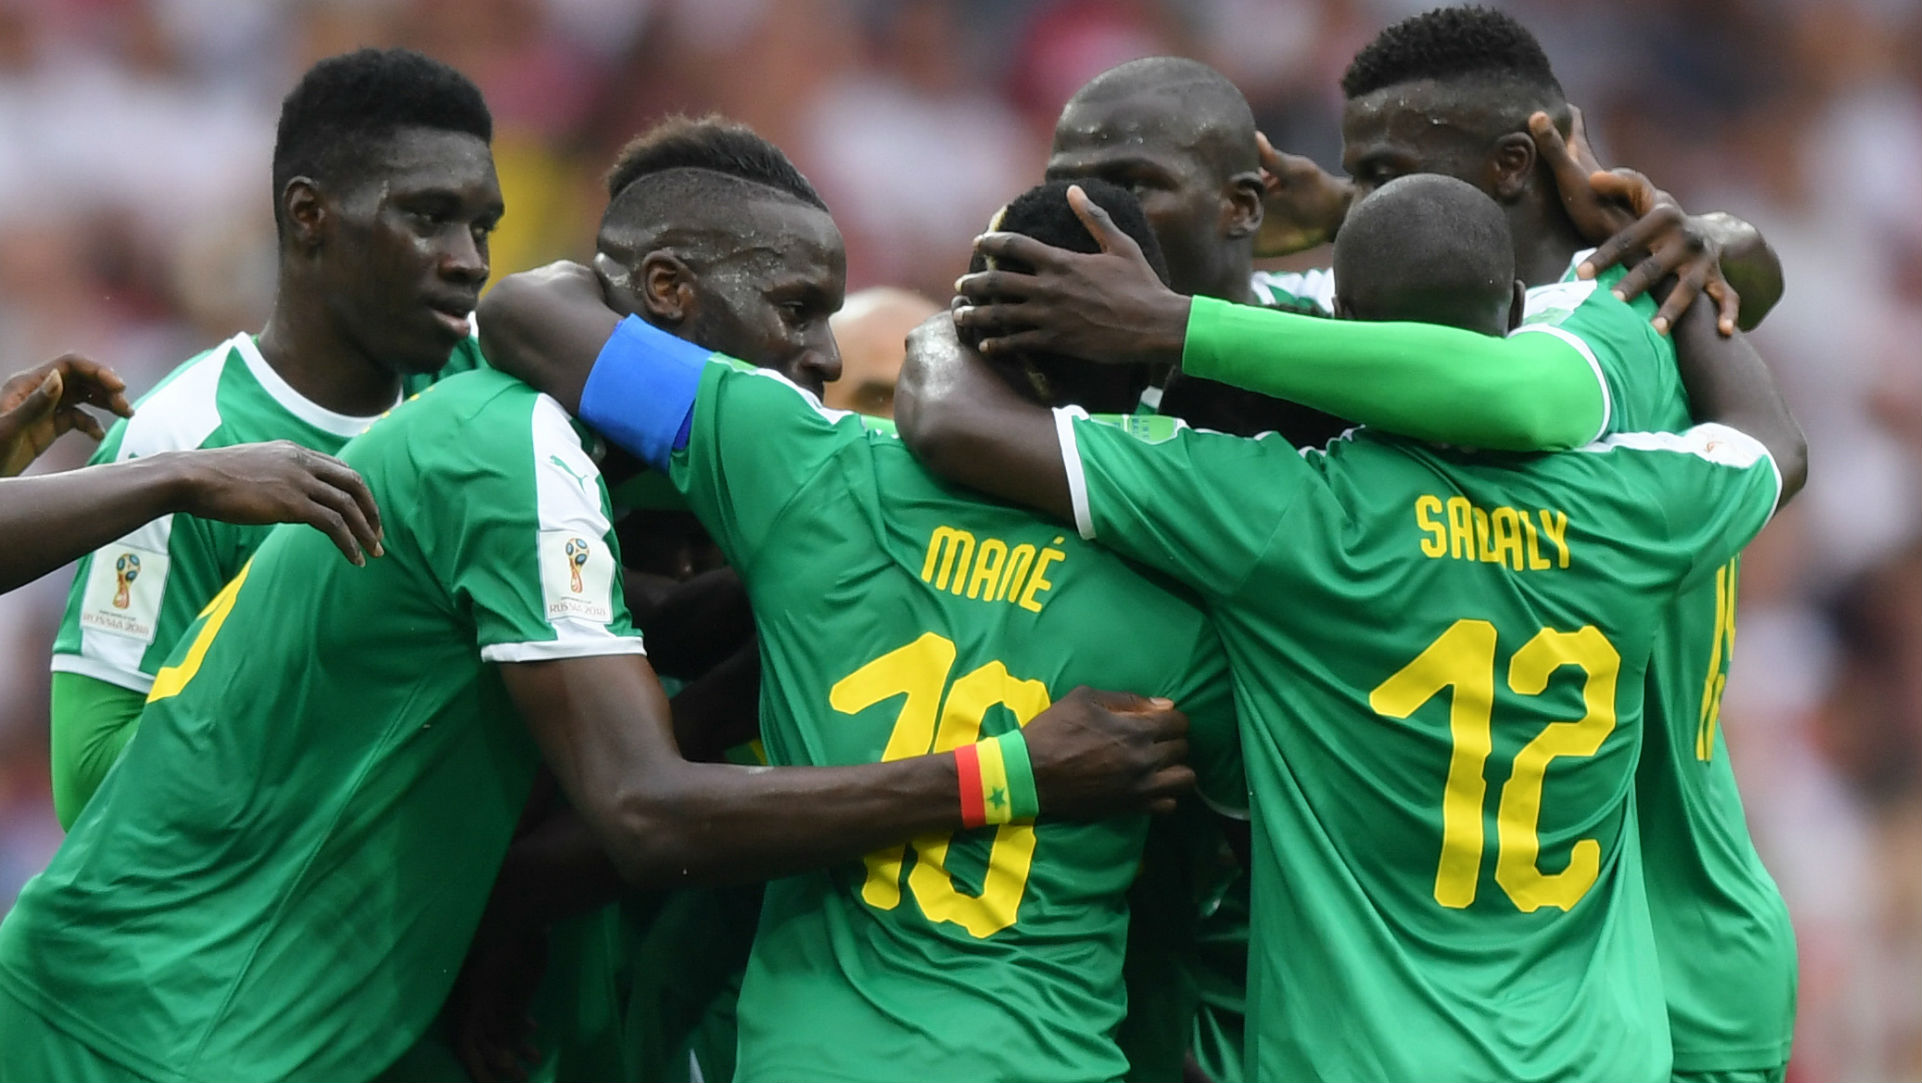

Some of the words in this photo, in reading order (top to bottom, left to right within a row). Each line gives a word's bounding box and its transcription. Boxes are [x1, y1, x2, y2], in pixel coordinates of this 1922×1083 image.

[921, 525, 1067, 613] MANÉ
[829, 631, 1052, 939] 10
[1369, 618, 1621, 914] 12
